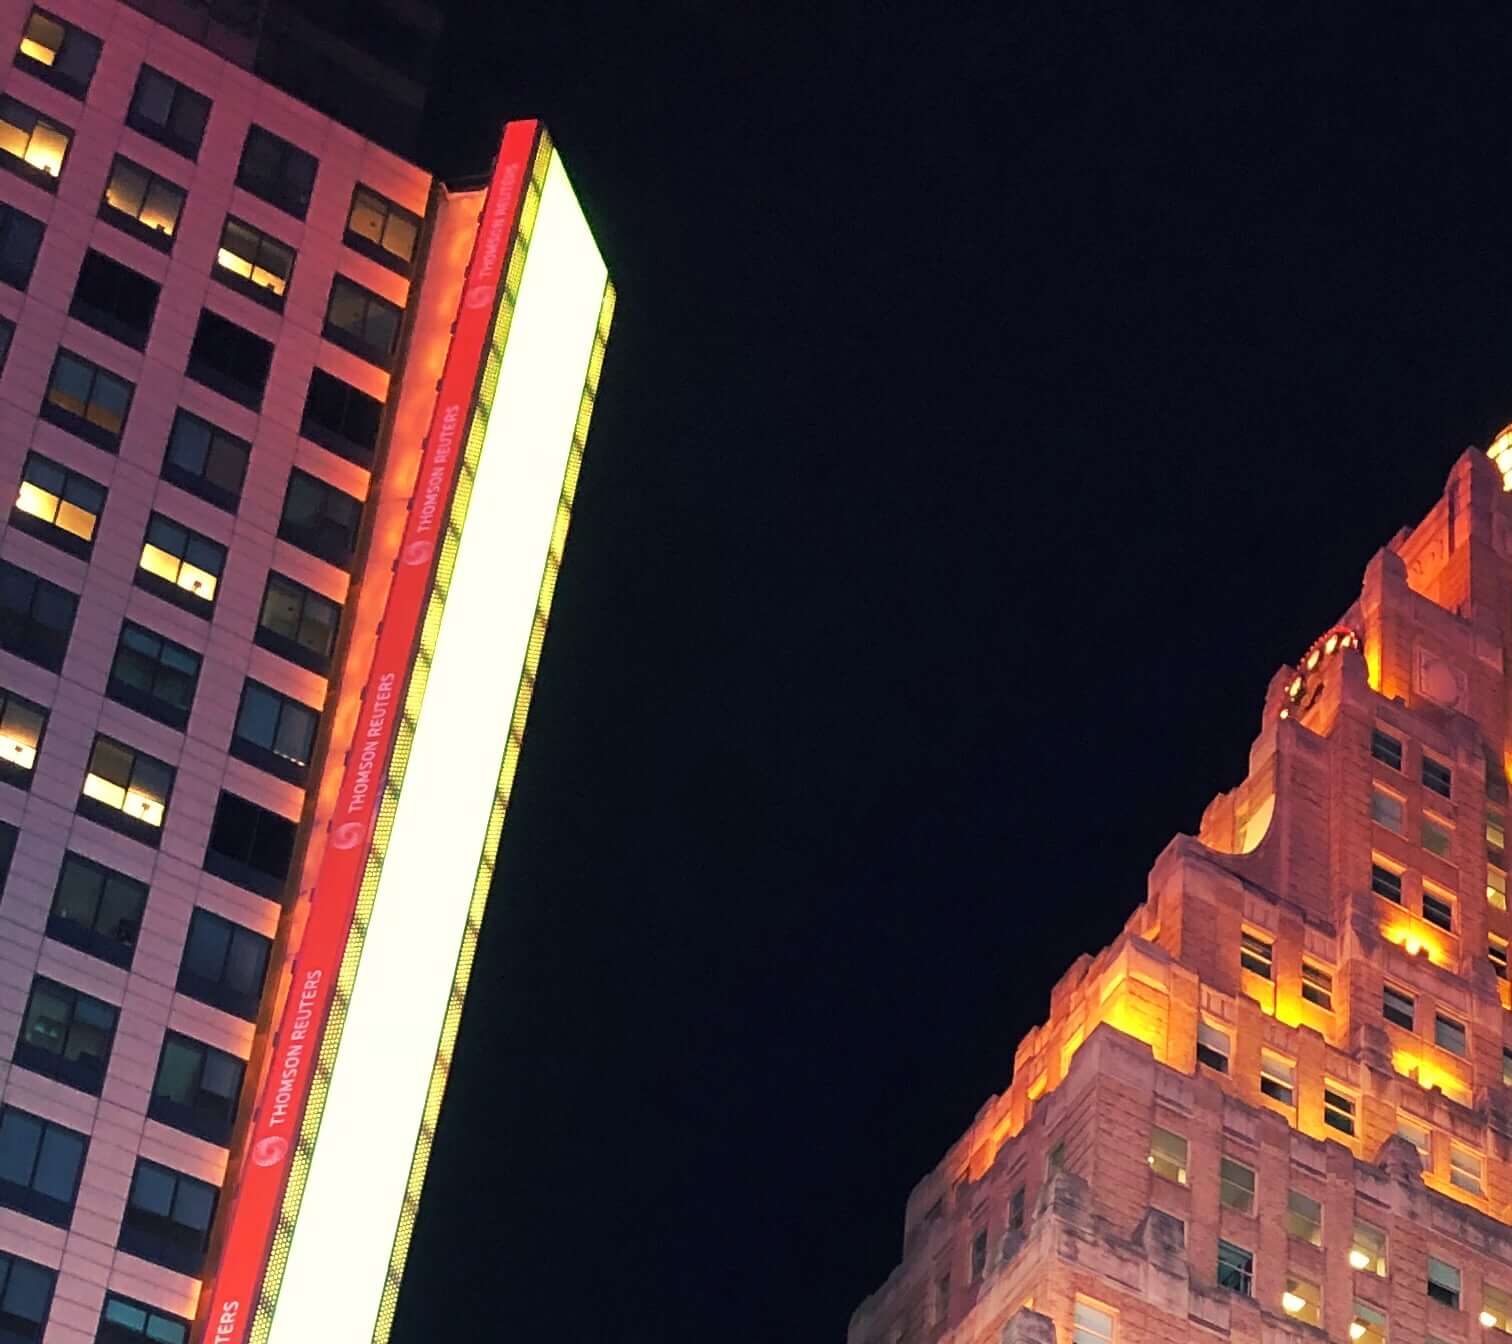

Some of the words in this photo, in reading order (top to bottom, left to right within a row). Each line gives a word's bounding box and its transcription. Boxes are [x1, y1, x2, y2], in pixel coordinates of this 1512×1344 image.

[479, 218, 505, 278] THOMSON
[497, 162, 519, 215] REUTERS
[417, 469, 446, 532] THOMSON
[434, 404, 460, 466] REUTERS
[348, 739, 378, 814] THOMSON
[367, 672, 396, 736] REUTERS
[269, 1047, 302, 1127] THOMSON
[290, 969, 322, 1043] REUTERS
